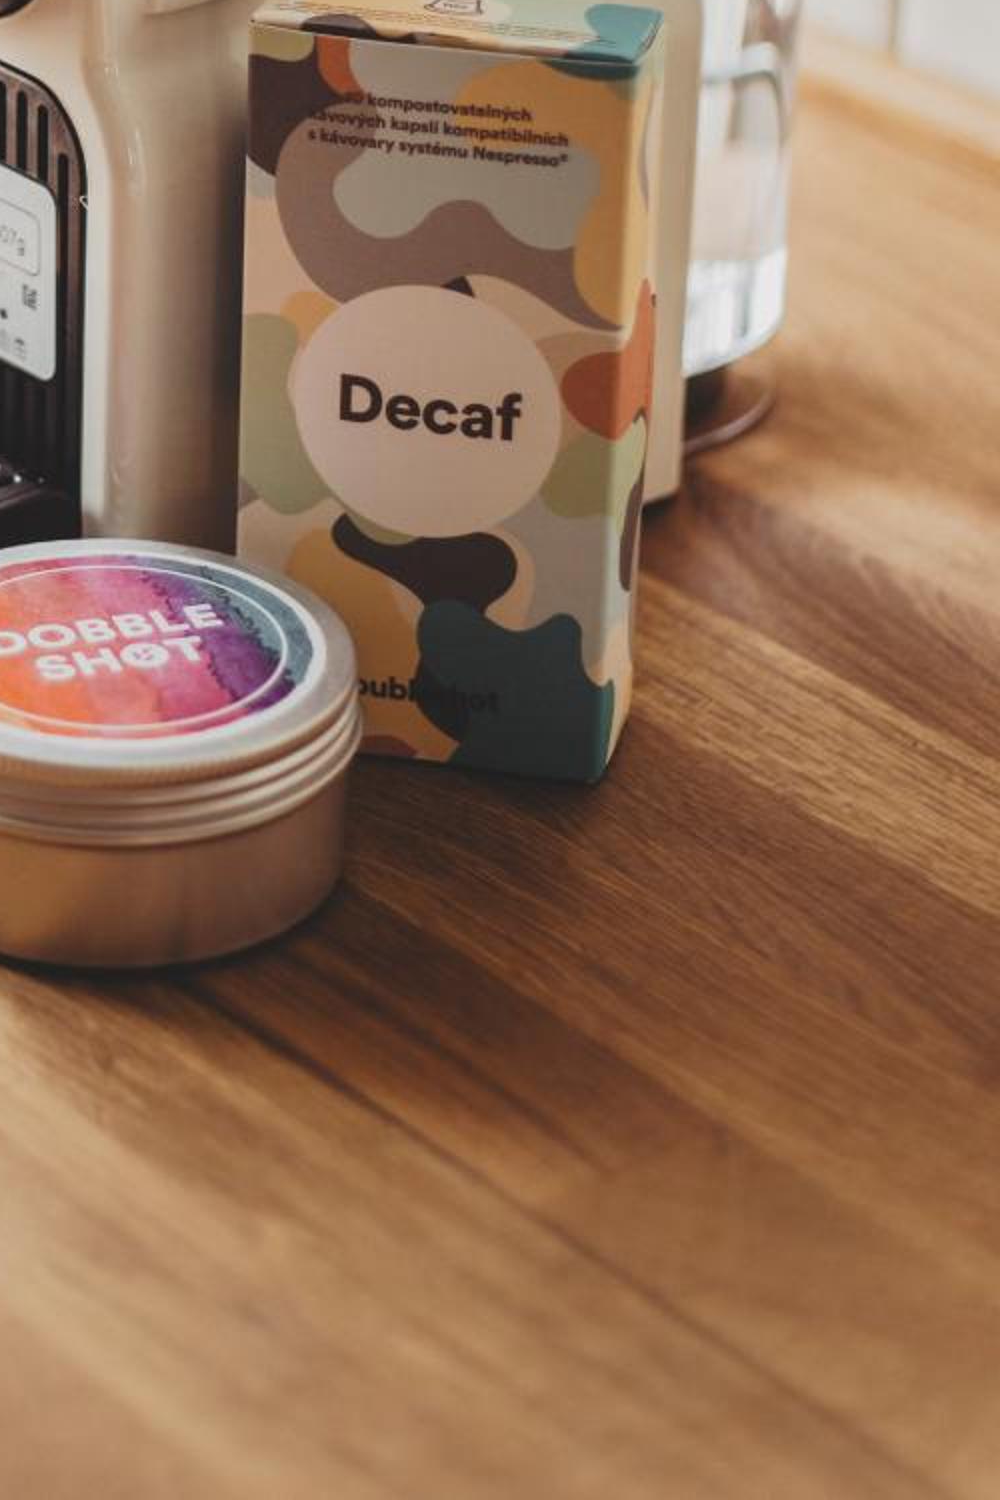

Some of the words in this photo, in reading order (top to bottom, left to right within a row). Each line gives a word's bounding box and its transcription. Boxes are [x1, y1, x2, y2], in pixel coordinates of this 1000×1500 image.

[367, 93, 532, 122] kompostovatelných
[320, 127, 394, 153] kávovary
[399, 139, 468, 159] systému
[339, 373, 522, 441] Decaf
[34, 635, 202, 682] SHOT
